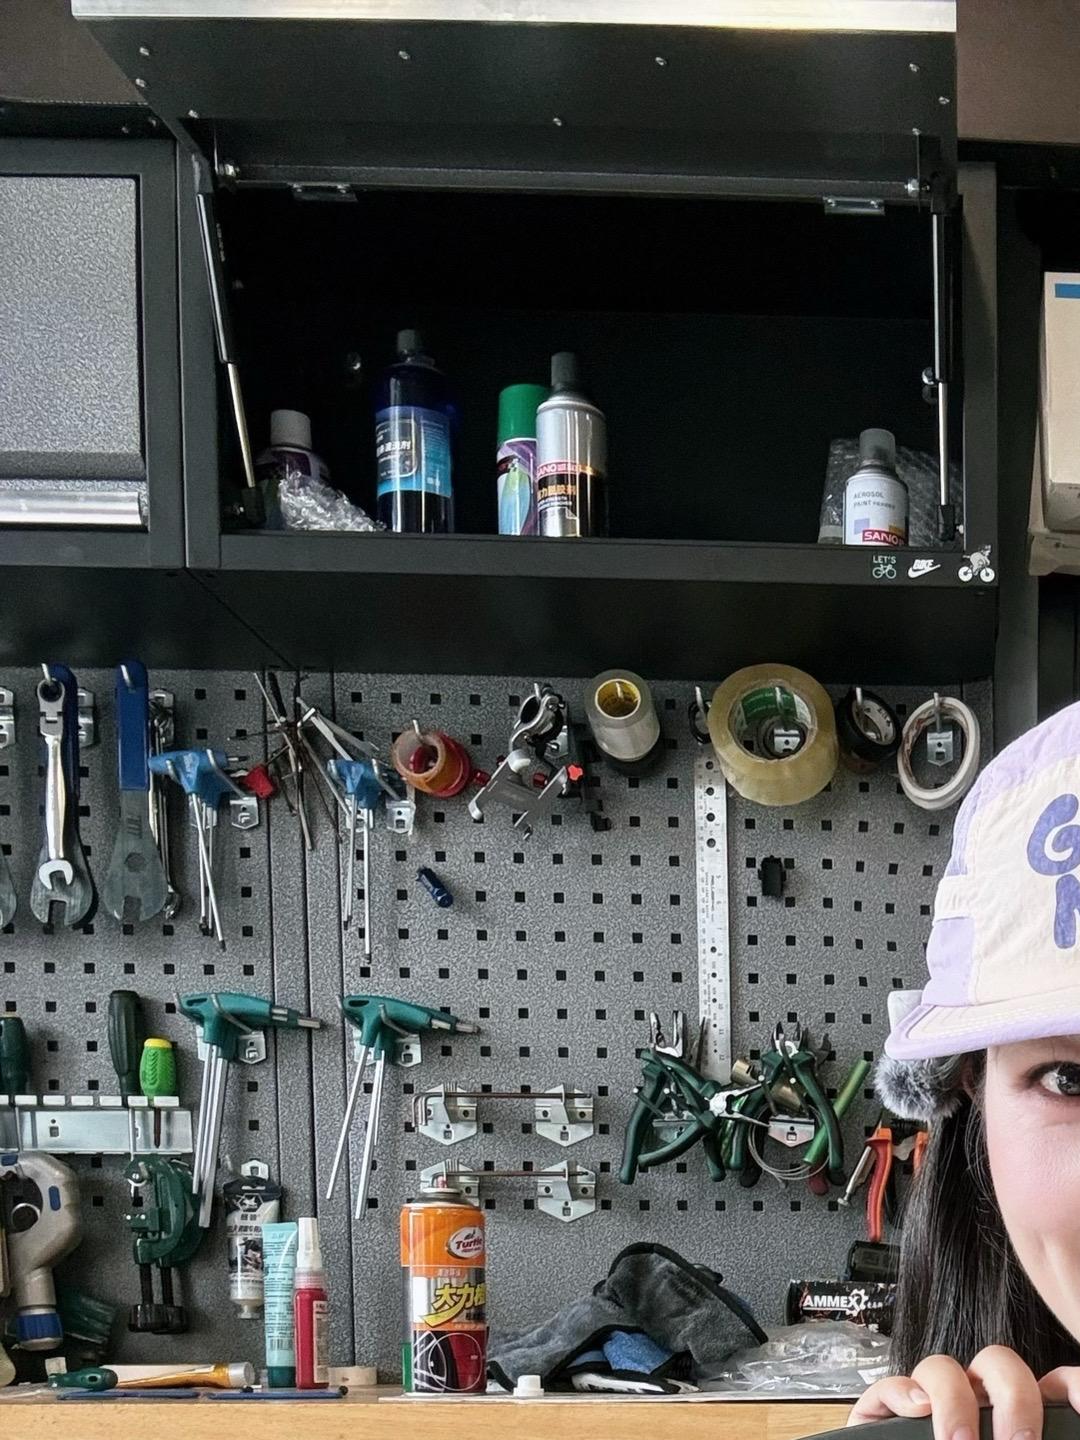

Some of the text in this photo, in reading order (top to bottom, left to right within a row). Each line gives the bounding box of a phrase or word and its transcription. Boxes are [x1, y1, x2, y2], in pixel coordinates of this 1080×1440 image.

[853, 490, 885, 499] AEROSOL
[863, 531, 899, 545] SANO
[872, 555, 897, 564] LET'S
[913, 559, 934, 570] BIKE
[802, 1295, 863, 1313] AMMEX
